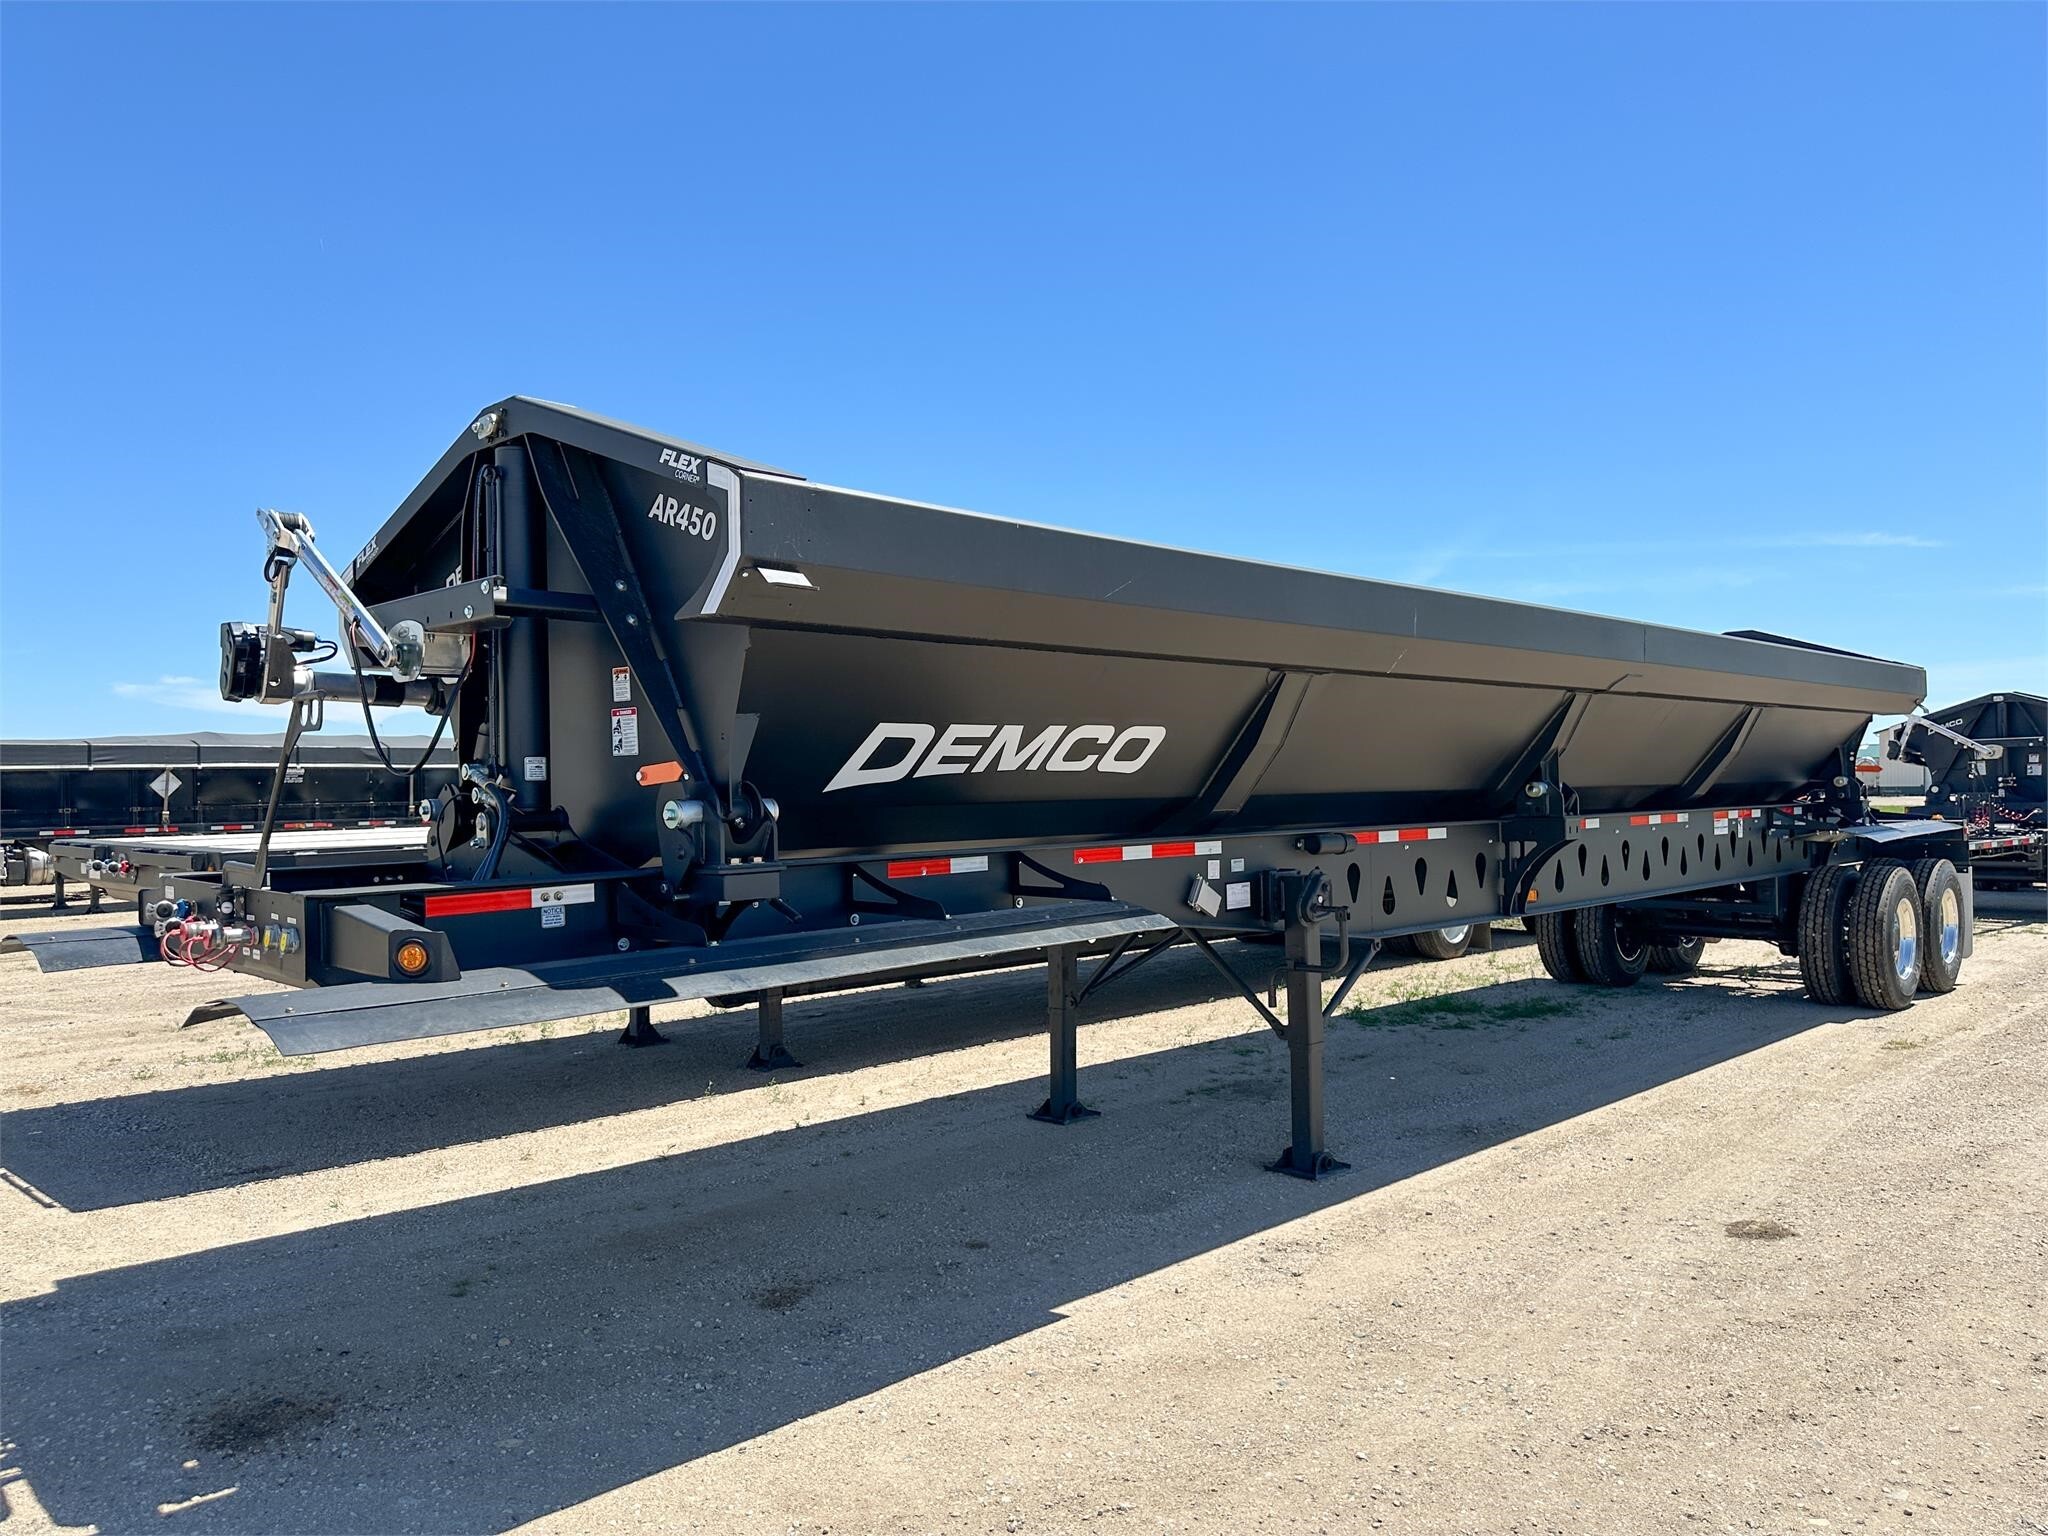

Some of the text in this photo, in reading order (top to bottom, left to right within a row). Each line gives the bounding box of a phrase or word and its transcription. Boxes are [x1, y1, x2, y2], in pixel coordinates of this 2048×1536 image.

[659, 448, 701, 474] FLEX
[648, 493, 716, 540] AR450
[356, 536, 377, 568] FLEX
[822, 722, 1166, 793] DEMCO
